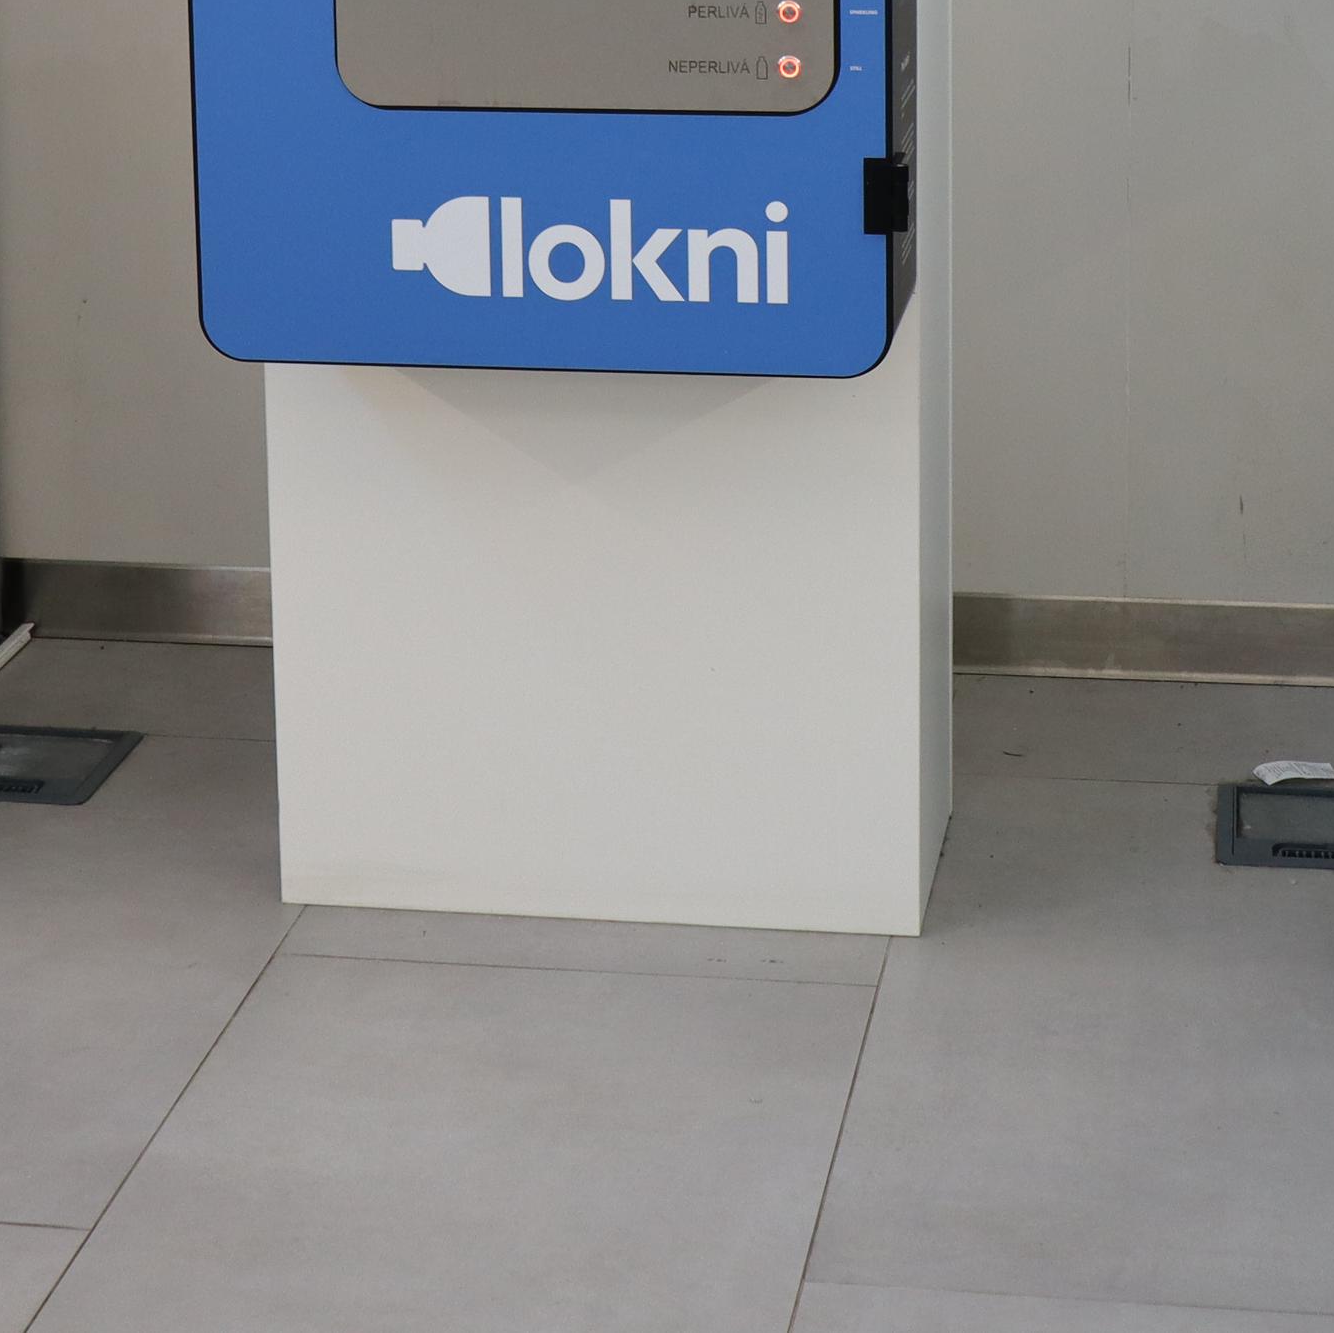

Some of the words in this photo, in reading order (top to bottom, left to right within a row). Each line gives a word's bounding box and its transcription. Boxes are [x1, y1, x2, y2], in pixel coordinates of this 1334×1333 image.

[687, 4, 750, 19] PERLIVÁ
[668, 58, 750, 75] NEPERLIVÁ
[500, 196, 790, 305] lokni
